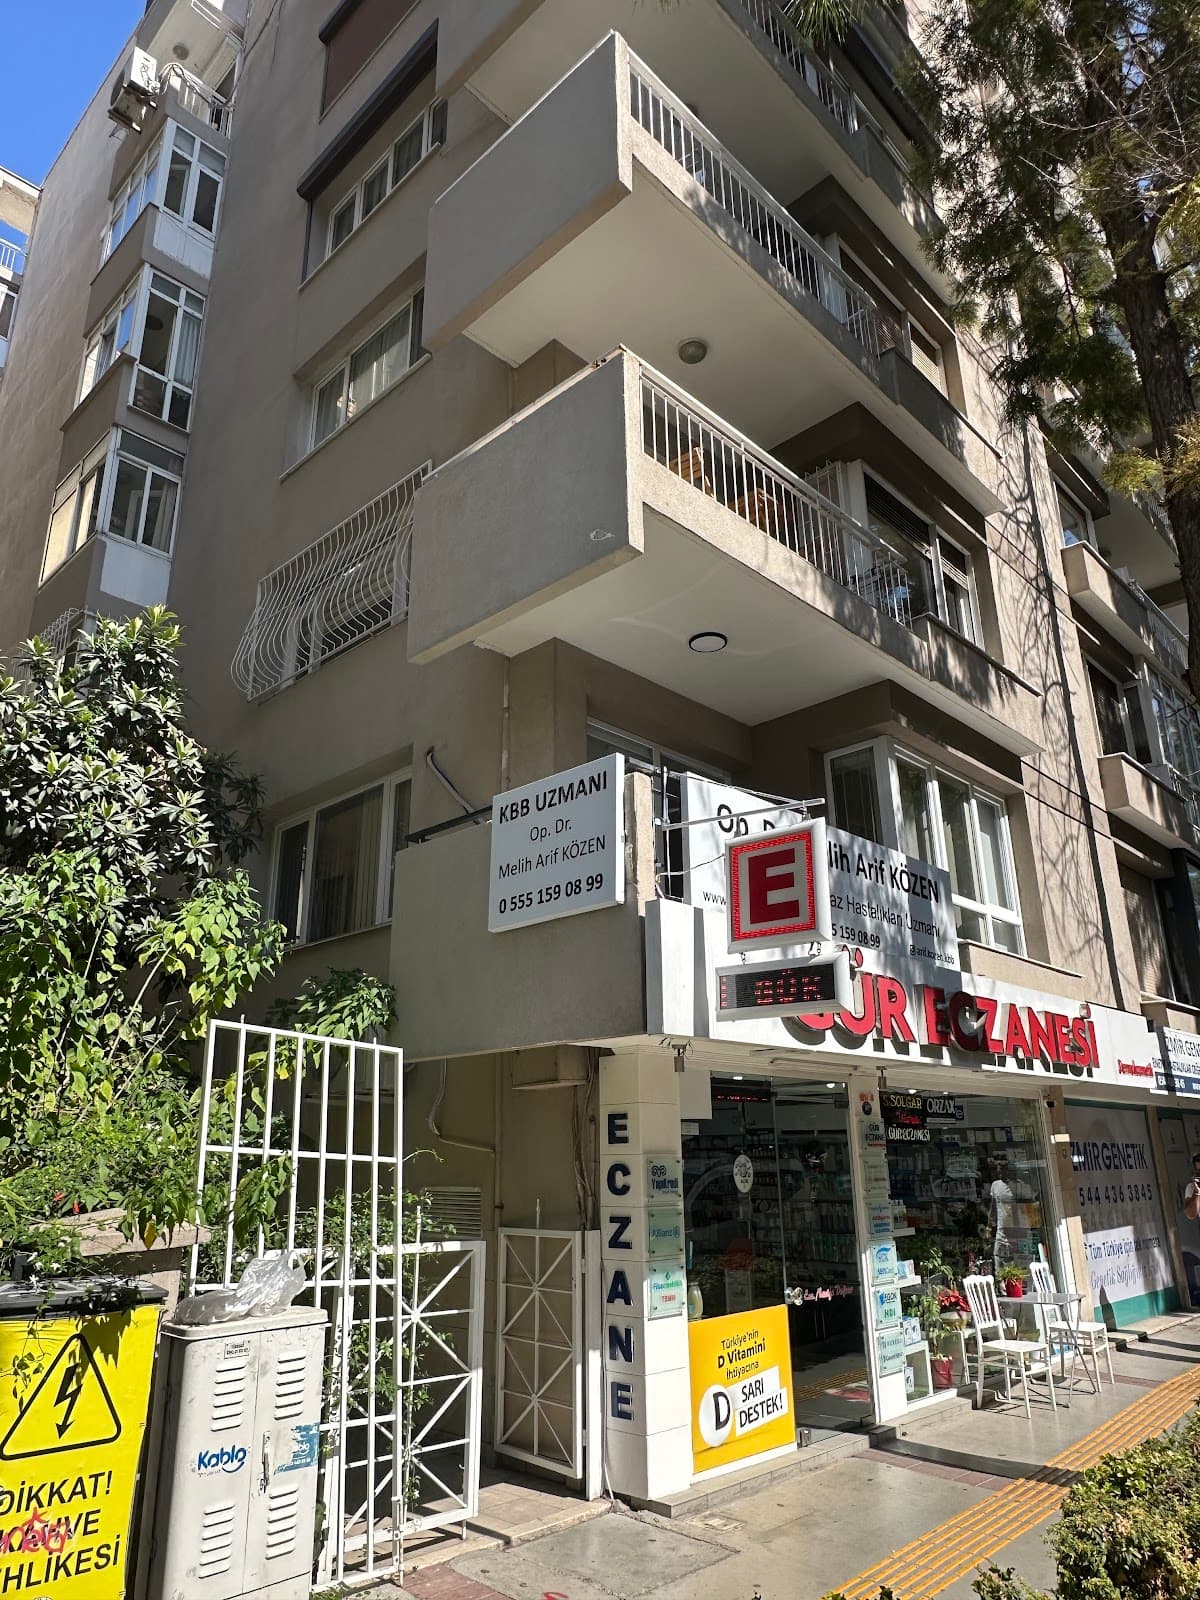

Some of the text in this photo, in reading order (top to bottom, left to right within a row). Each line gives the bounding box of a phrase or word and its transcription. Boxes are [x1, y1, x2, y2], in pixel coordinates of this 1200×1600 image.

[499, 770, 607, 824] KBB UZMANI
[530, 818, 572, 842] Op. Dr.
[717, 804, 749, 836] Op
[498, 834, 606, 879] Melih Arif KÖZEN
[828, 841, 939, 903] lih Arif KÖZEN
[499, 872, 604, 914] 0 555 159 08 99
[702, 889, 727, 906] www
[747, 847, 800, 925] E
[830, 894, 844, 910] az
[904, 912, 940, 938] Uzmanı
[839, 925, 856, 941] 159
[858, 930, 869, 946] 08
[870, 932, 881, 948] 99
[921, 984, 1100, 1068] ECZANESİ
[1164, 1033, 1186, 1055] ZMİR
[890, 1095, 922, 1109] SOLGAR
[927, 1098, 956, 1114] ORZAX
[1069, 1140, 1102, 1172] ZMİR
[1078, 1183, 1153, 1207] 544 436 3845
[1088, 1242, 1103, 1260] Tüm
[1102, 1239, 1123, 1259] Türkiye
[606, 1112, 634, 1421] ECZANE
[717, 1337, 766, 1369] D Vitamini
[720, 1328, 759, 1350] Türkiye'nin
[726, 1360, 760, 1381] İhtiyacına
[741, 1377, 764, 1404] SARI
[712, 1391, 731, 1431] D
[739, 1391, 783, 1429] DESTEK!
[197, 1443, 247, 1471] Kablo
[0, 1533, 121, 1594] HLİKESİ
